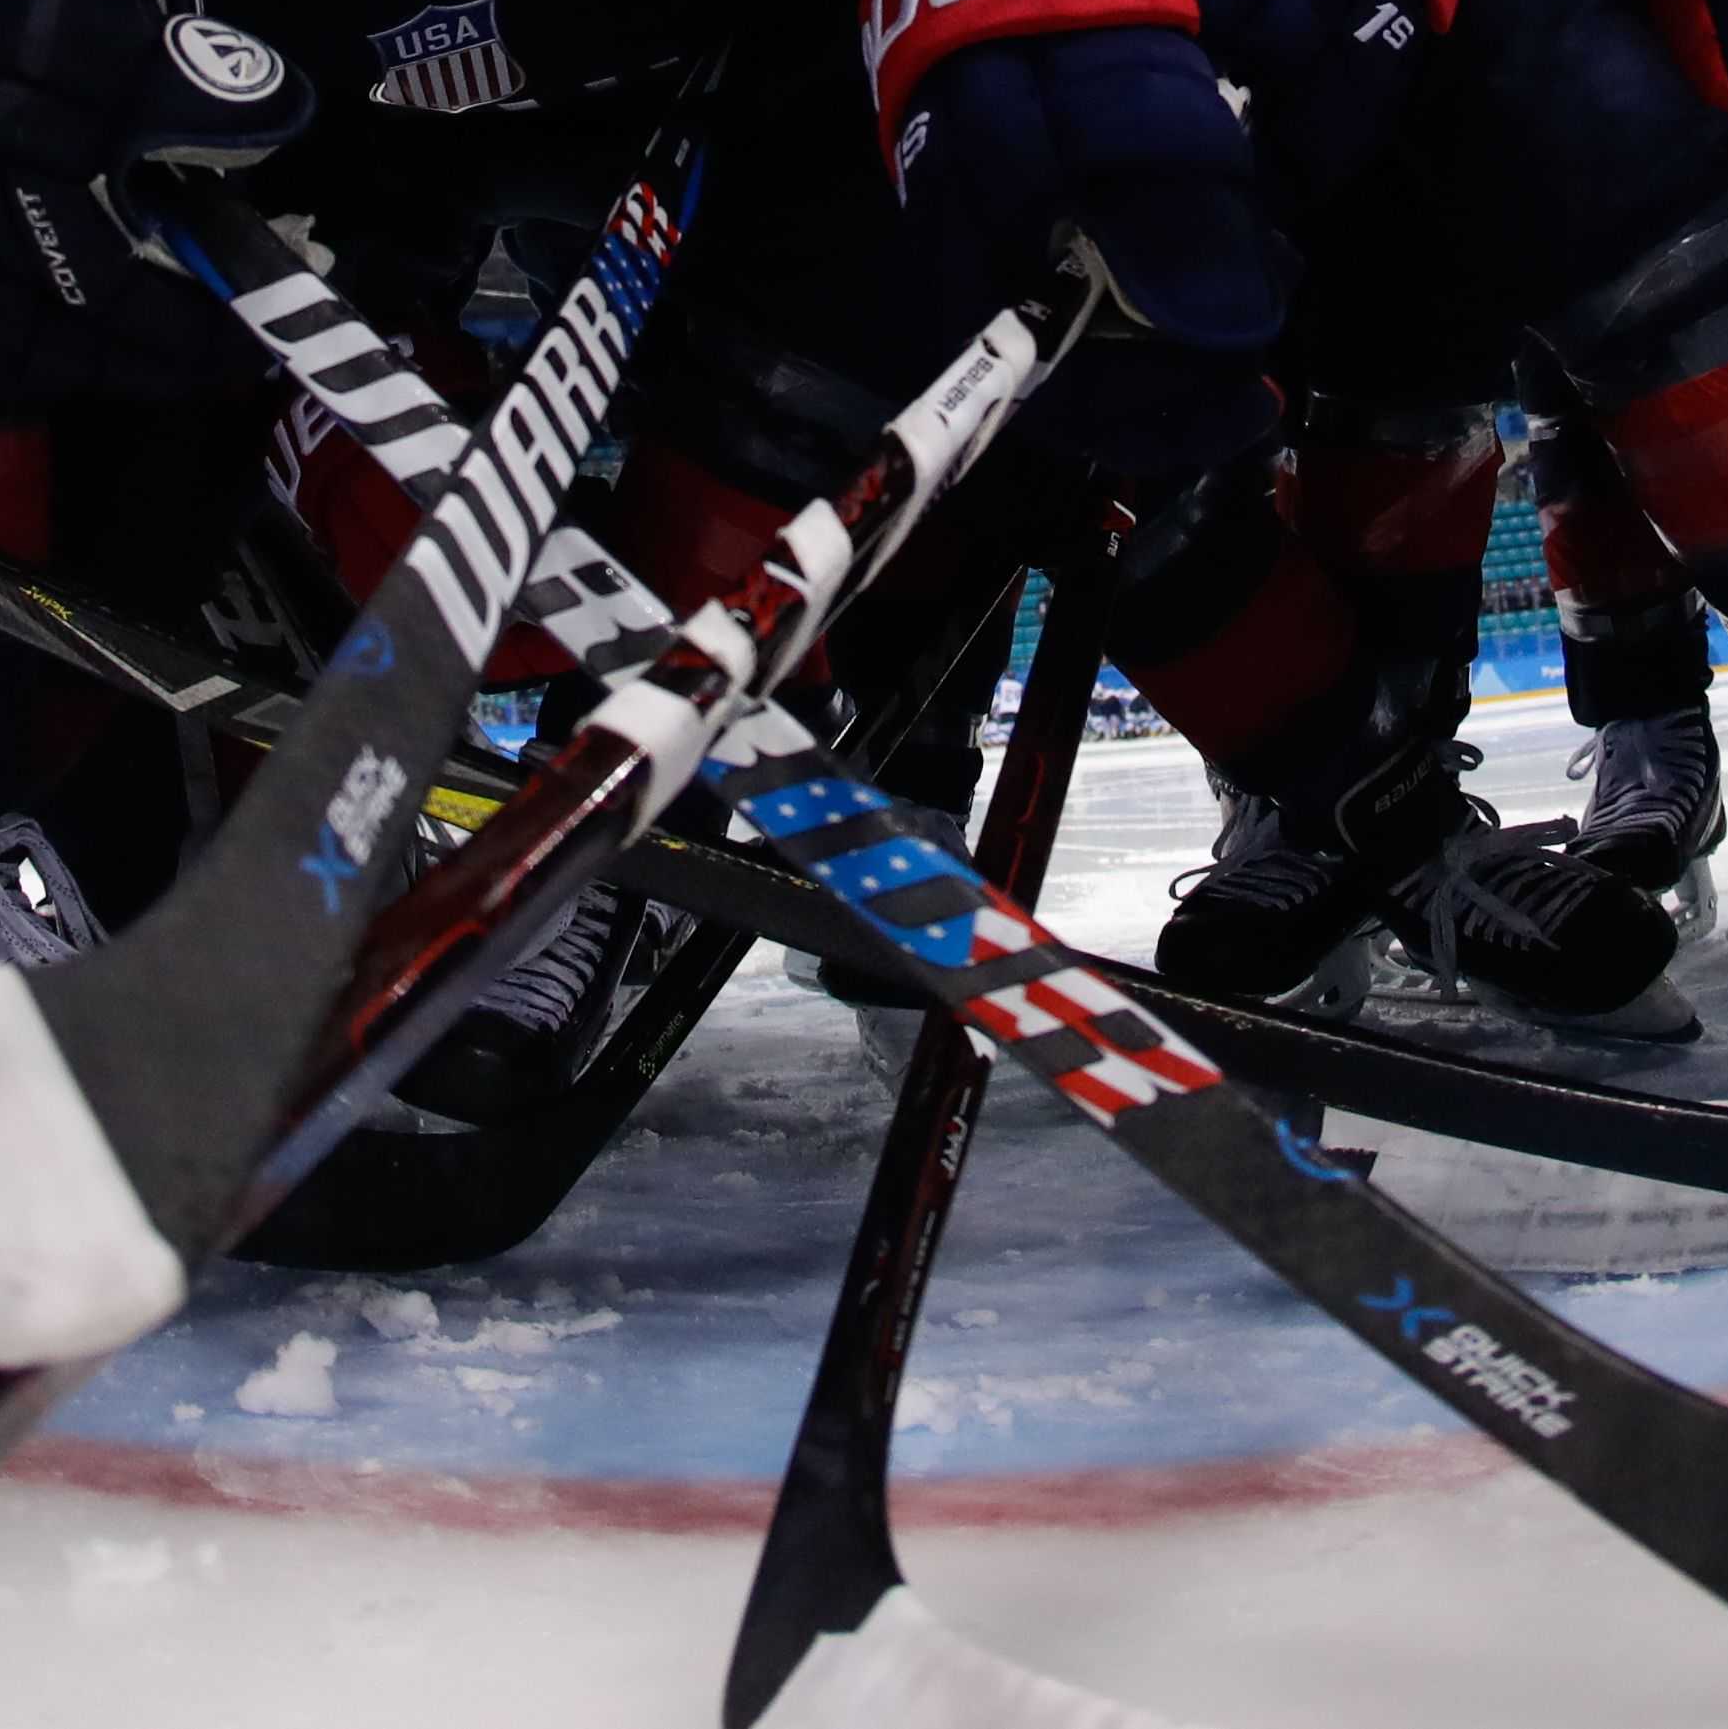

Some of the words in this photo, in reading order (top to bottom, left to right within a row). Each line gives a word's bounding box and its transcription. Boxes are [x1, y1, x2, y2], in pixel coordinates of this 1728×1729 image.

[393, 15, 481, 63] USA
[15, 185, 86, 308] COVERT
[941, 356, 995, 411] BAUER
